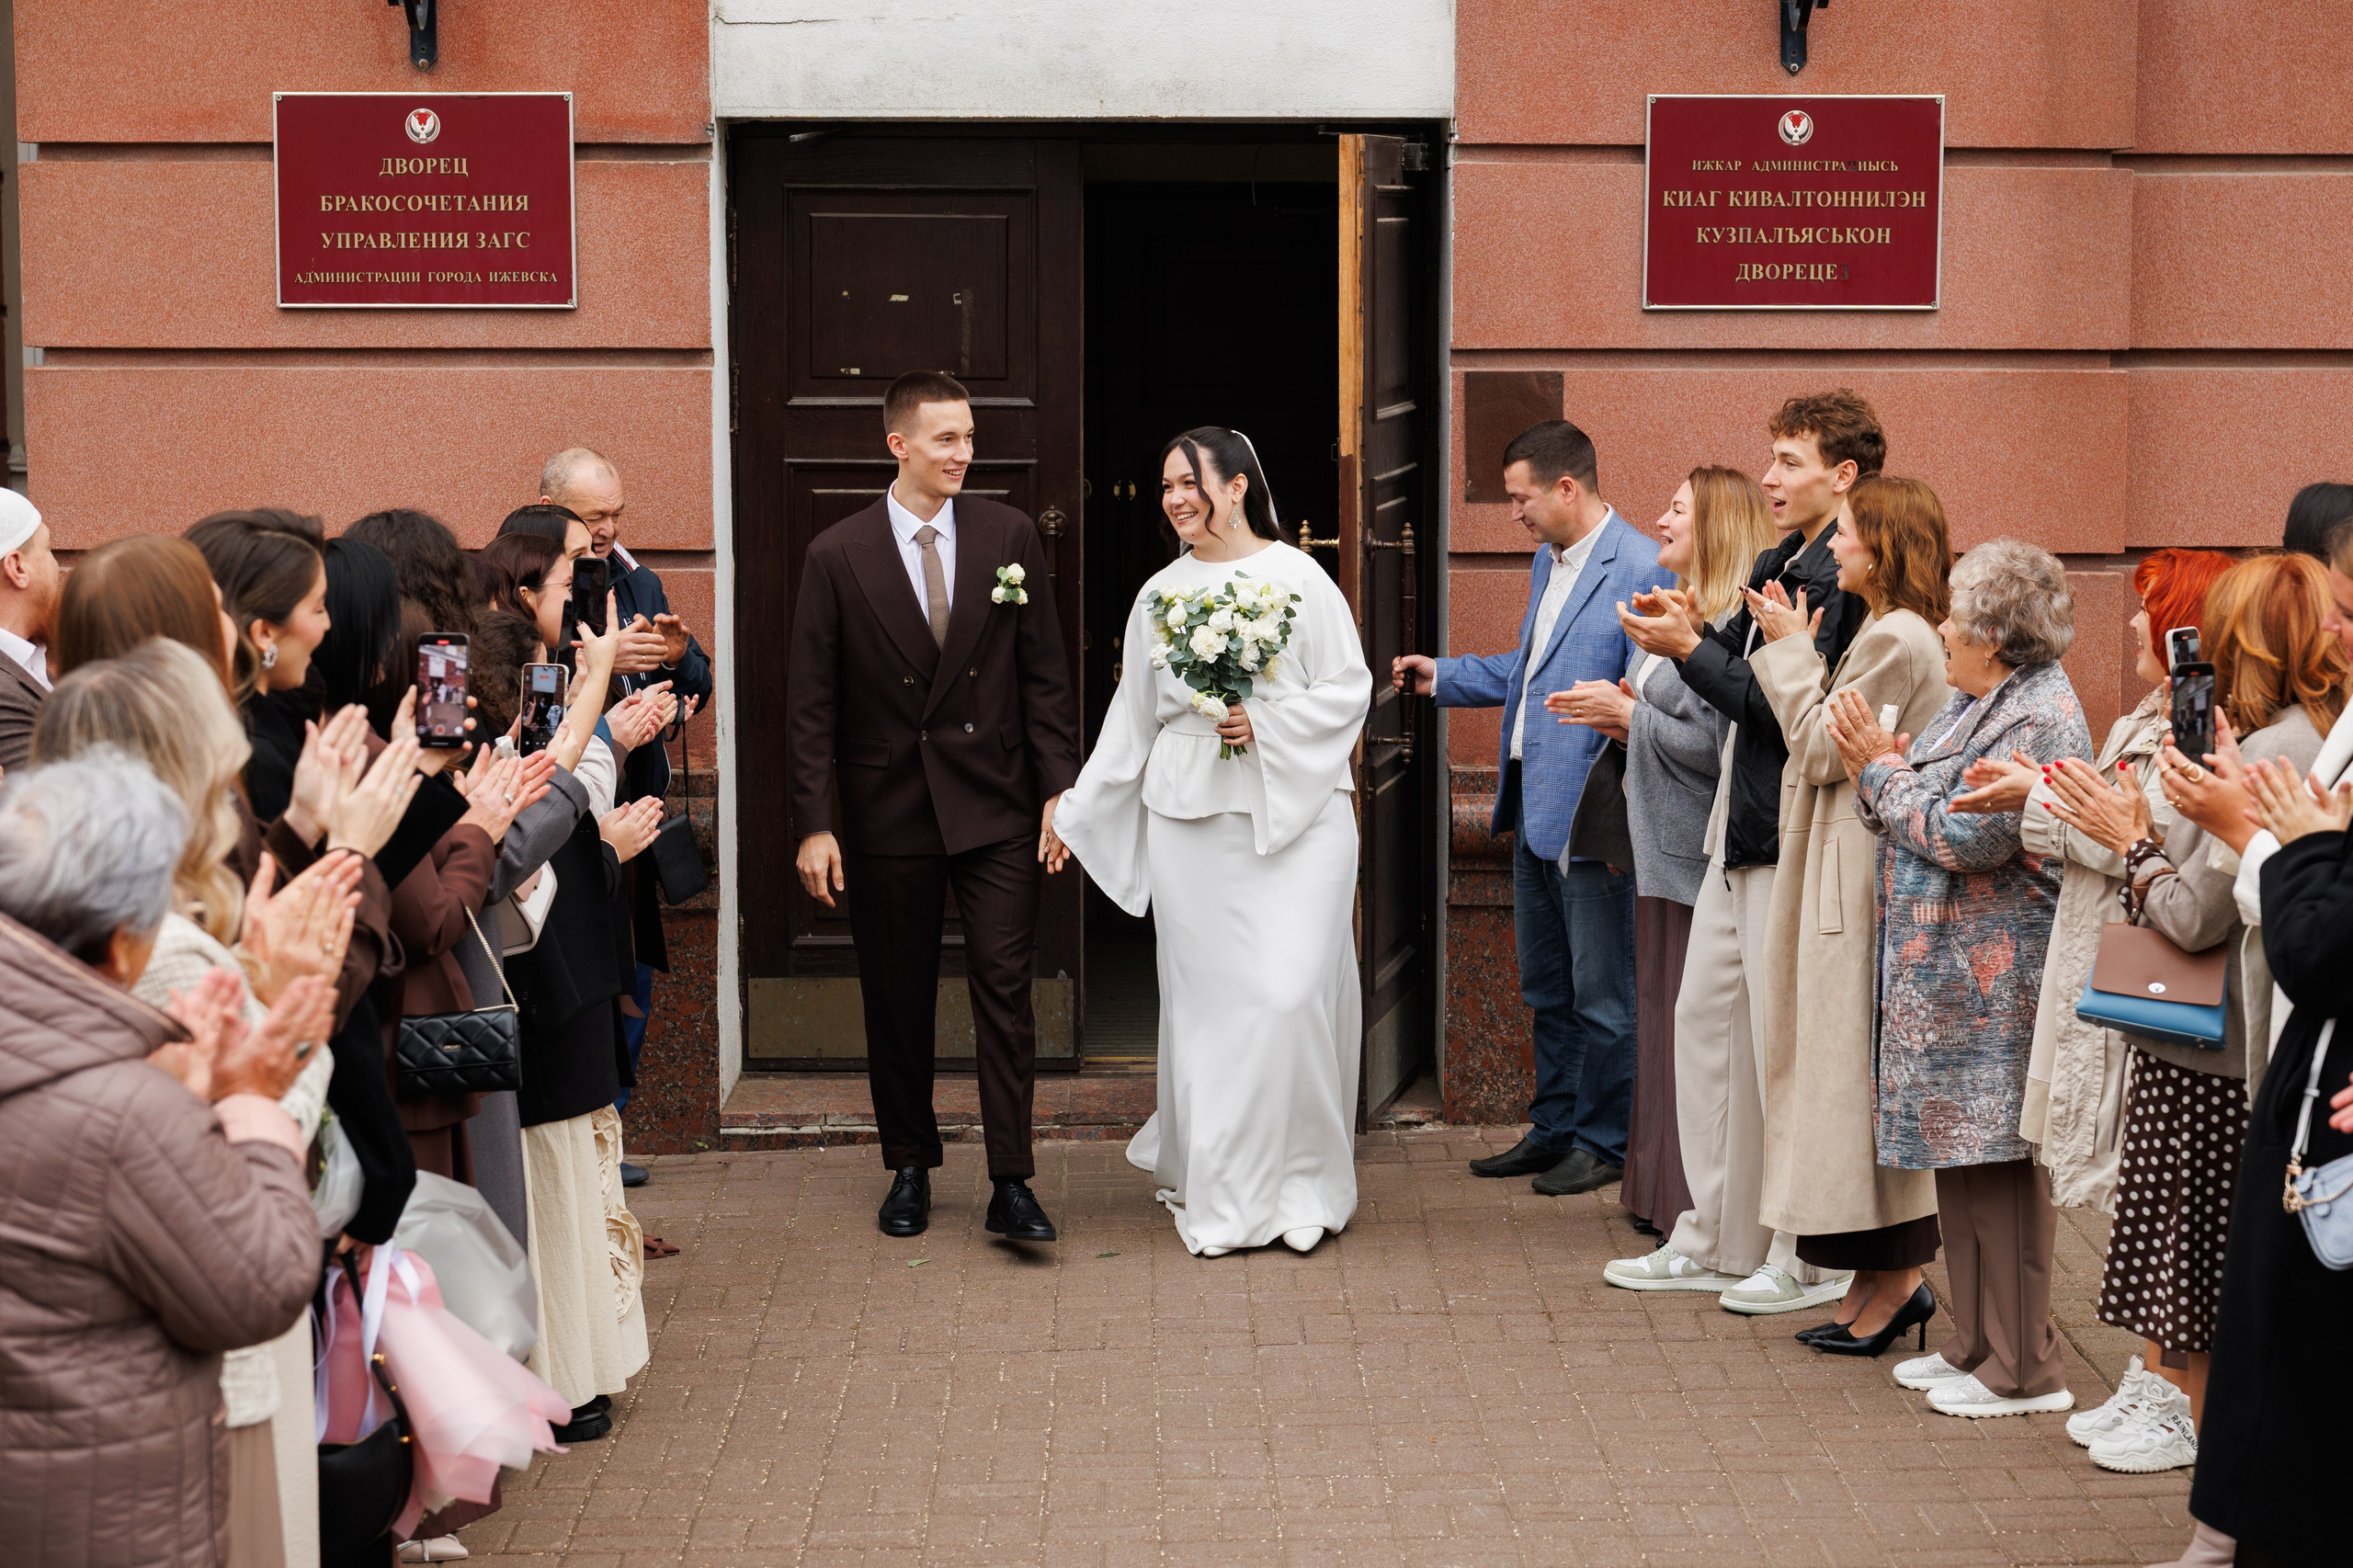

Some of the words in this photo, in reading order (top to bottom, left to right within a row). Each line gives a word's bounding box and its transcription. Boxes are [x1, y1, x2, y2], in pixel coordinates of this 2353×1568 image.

[380, 157, 469, 177] ДВОРЕЦ
[1692, 160, 1742, 172] ИЖКАР
[320, 195, 529, 211] БРАКОСОЧЕТАНИЯ
[1662, 190, 1722, 207] КИАГ
[1728, 190, 1927, 208] КИВАЛТОННИЛЭН
[321, 233, 469, 249] УПРАВЛЕНИЯ
[475, 232, 530, 248] ЗАГС
[1696, 227, 1891, 244] КУЗПАЛЪЯСЬКОН
[294, 272, 421, 284] АДМИНИСТРАЦИИ
[428, 272, 482, 283] ГОРОДА
[489, 272, 558, 282] ИЖЕВСКА
